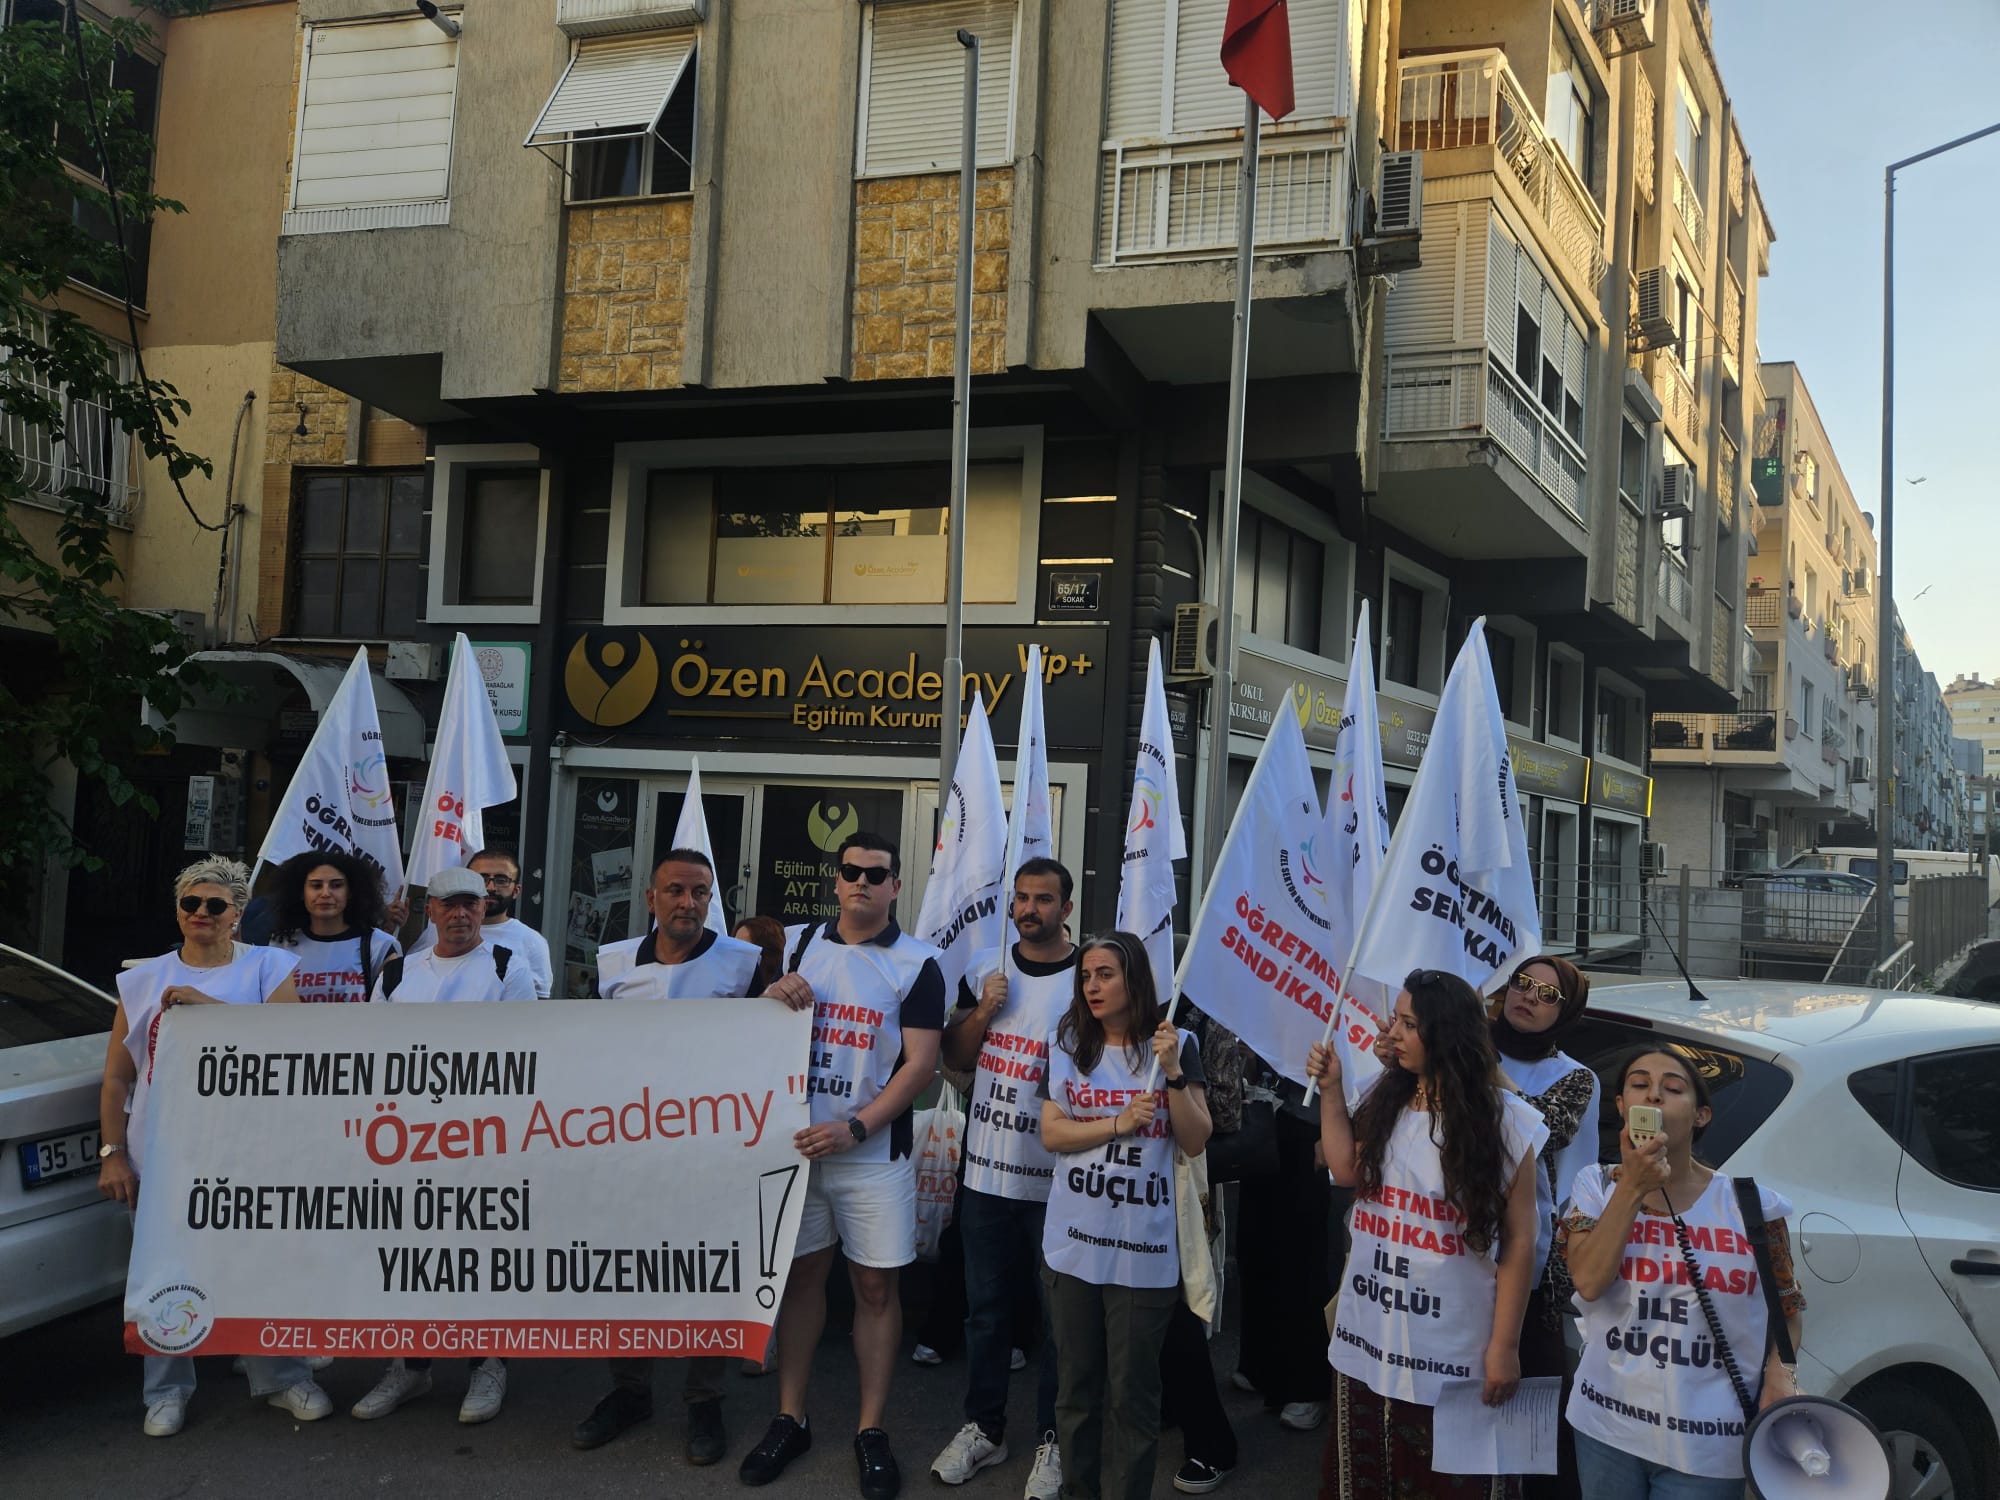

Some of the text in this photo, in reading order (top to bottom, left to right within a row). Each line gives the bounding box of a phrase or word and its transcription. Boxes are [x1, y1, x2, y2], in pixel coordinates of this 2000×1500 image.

[671, 638, 786, 697] Özen
[1240, 683, 1264, 702] OKUL
[500, 709, 522, 717] KURSU
[793, 703, 865, 731] Eğitim
[1229, 701, 1272, 725] KURSLARI
[774, 861, 815, 878] Eğitim
[784, 881, 820, 898] AYT
[783, 902, 841, 917] ARA SINIF
[811, 1022, 875, 1051] DİKASI
[197, 1044, 537, 1104] ÖĞRETMEN DÜŞMANI
[807, 1075, 852, 1098] ÇLÜ!
[990, 1078, 1018, 1104] İLE
[521, 1086, 775, 1152] Academy
[974, 1102, 1038, 1134] GÜÇLÜ!
[40, 1141, 67, 1172] 35
[918, 1175, 956, 1194] FLO
[1068, 1162, 1170, 1208] GÜÇLÜ!
[187, 1178, 530, 1231] ÖĞRETMENİN ÖFKESİ
[1067, 1226, 1168, 1254] ÖĞRETMEN SENDİKASI
[1626, 1219, 1755, 1256] RETMEN
[378, 1247, 479, 1292] YIKAR
[491, 1248, 535, 1292] BU
[546, 1240, 741, 1293] DÜZENİNİZİ
[1373, 1243, 1410, 1279] İLE
[1353, 1273, 1441, 1318] GÜÇLÜ!
[1638, 1289, 1688, 1325] İLE
[259, 1321, 744, 1350] ÖZEL SEKTÖR ÖĞRETMENLERİ SENDİKASI
[1336, 1324, 1470, 1377] ÖĞRETMEN SENDİKASI
[1606, 1326, 1722, 1369] GÜÇLÜ!
[1581, 1378, 1660, 1426] ÖĞRETMEN
[1667, 1416, 1745, 1436] SENDİKA
